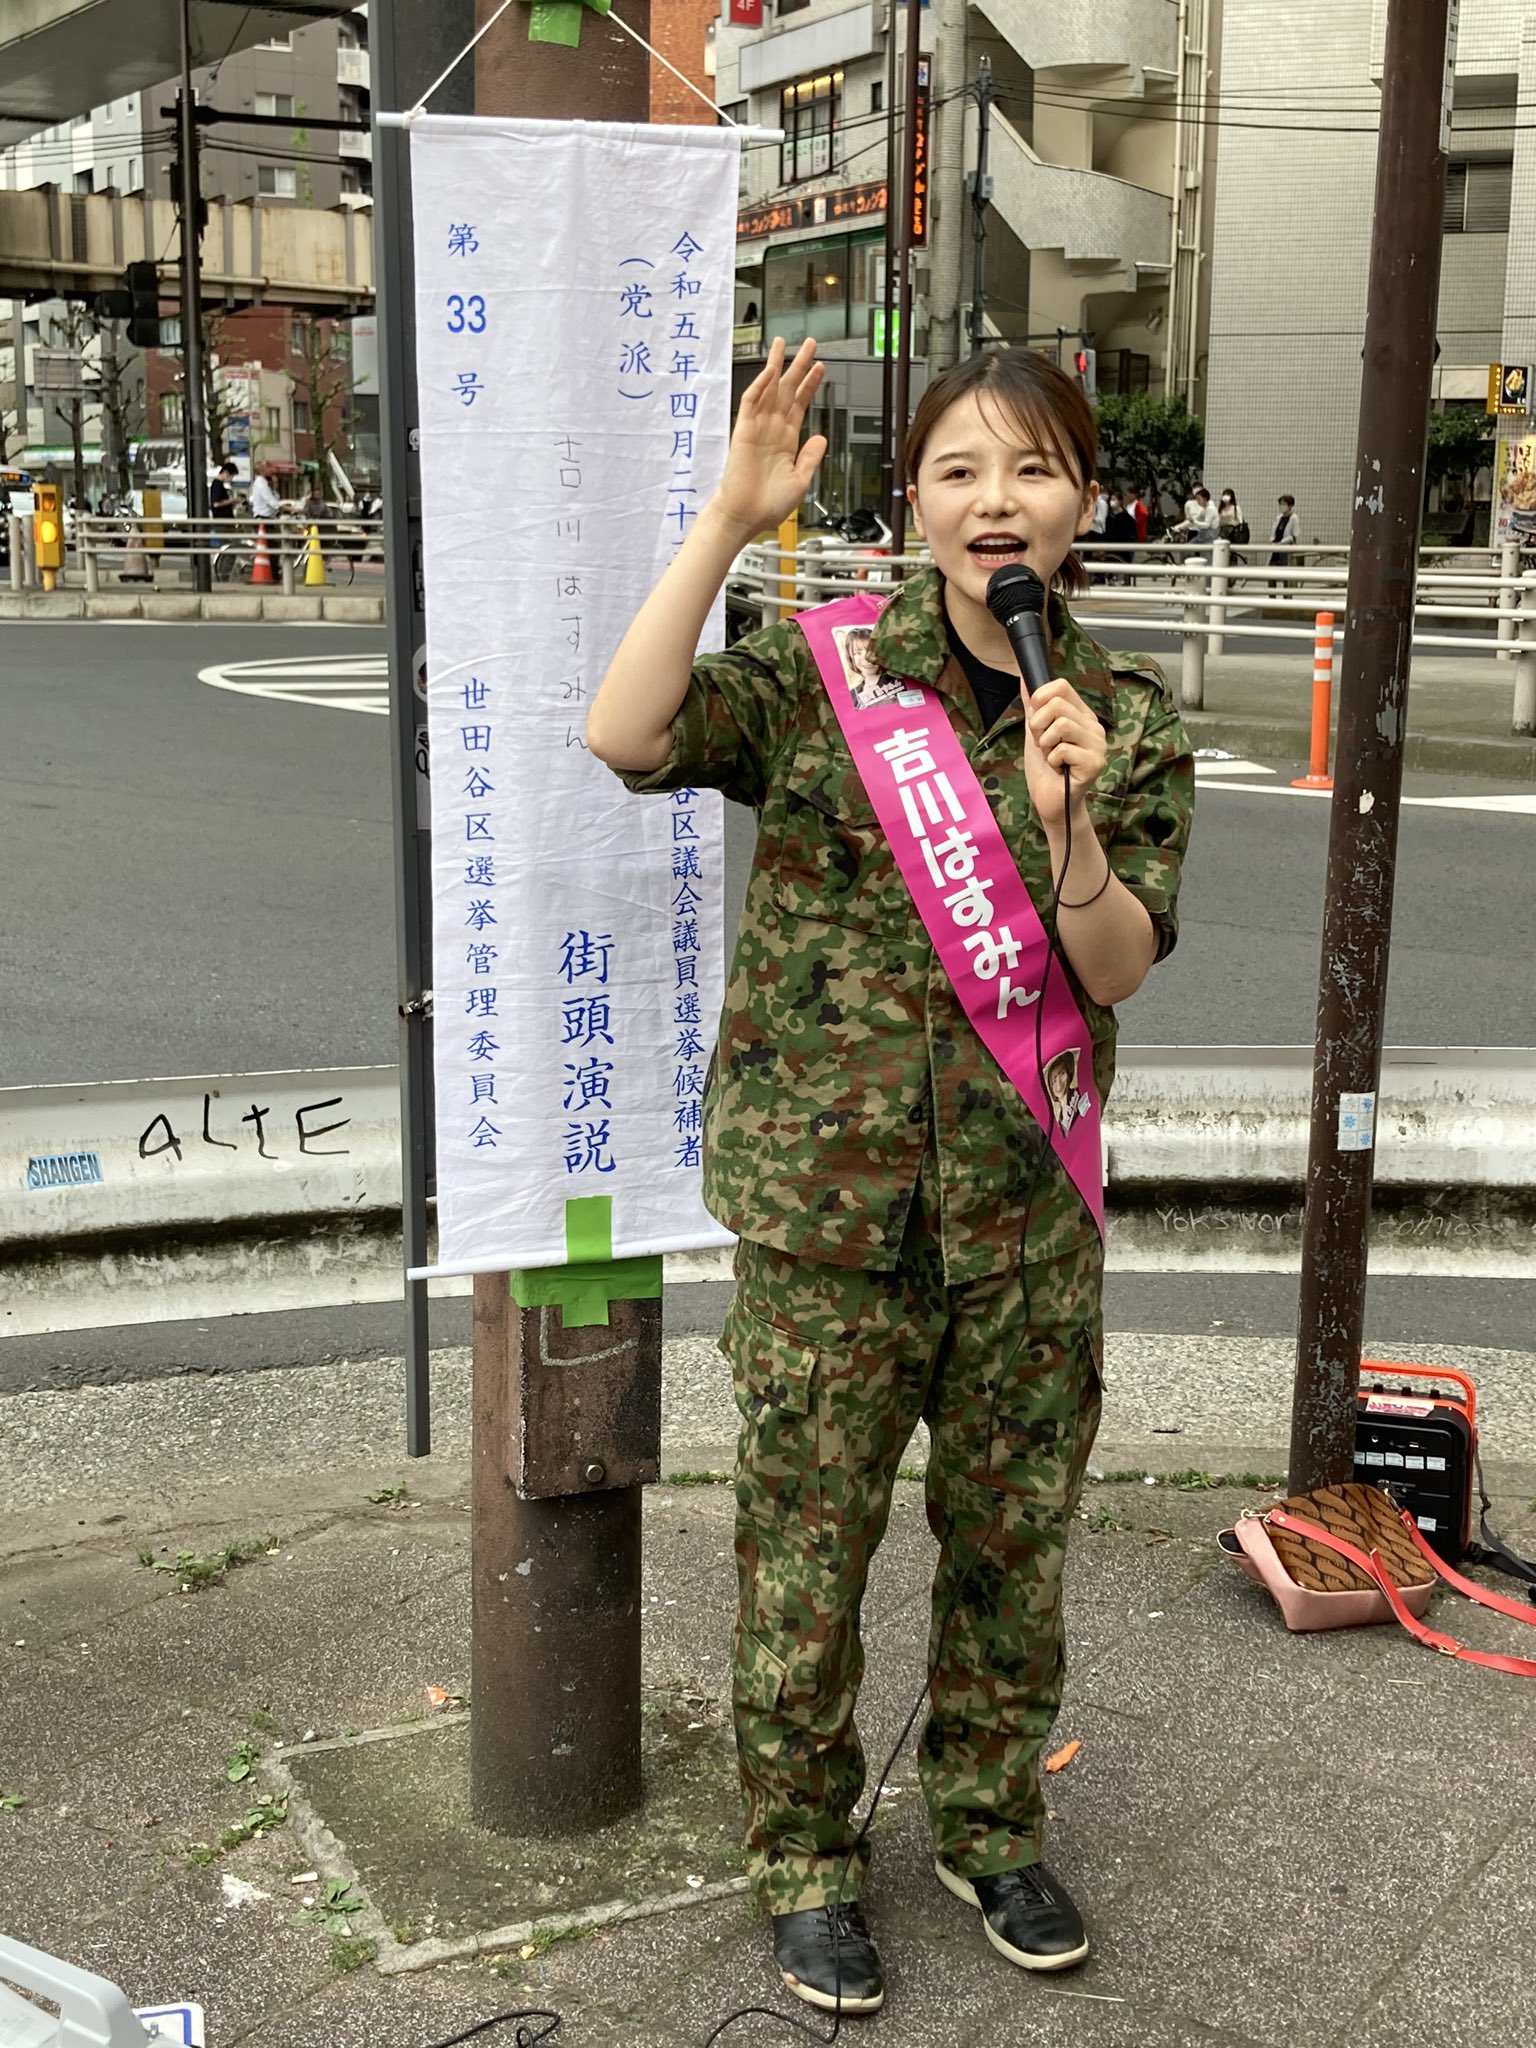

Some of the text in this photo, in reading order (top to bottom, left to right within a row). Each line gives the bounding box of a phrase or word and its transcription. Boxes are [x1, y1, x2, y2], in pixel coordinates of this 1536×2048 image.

[666, 231, 704, 566] 令和五年四月二十
[553, 435, 589, 750] 吉川はすみん
[459, 677, 503, 1149] 世田谷区選挙管理委員会
[873, 727, 1041, 1020] 吉川はすみん
[30, 1153, 101, 1187] SHANGEN
[557, 929, 617, 1175] 街頭演説
